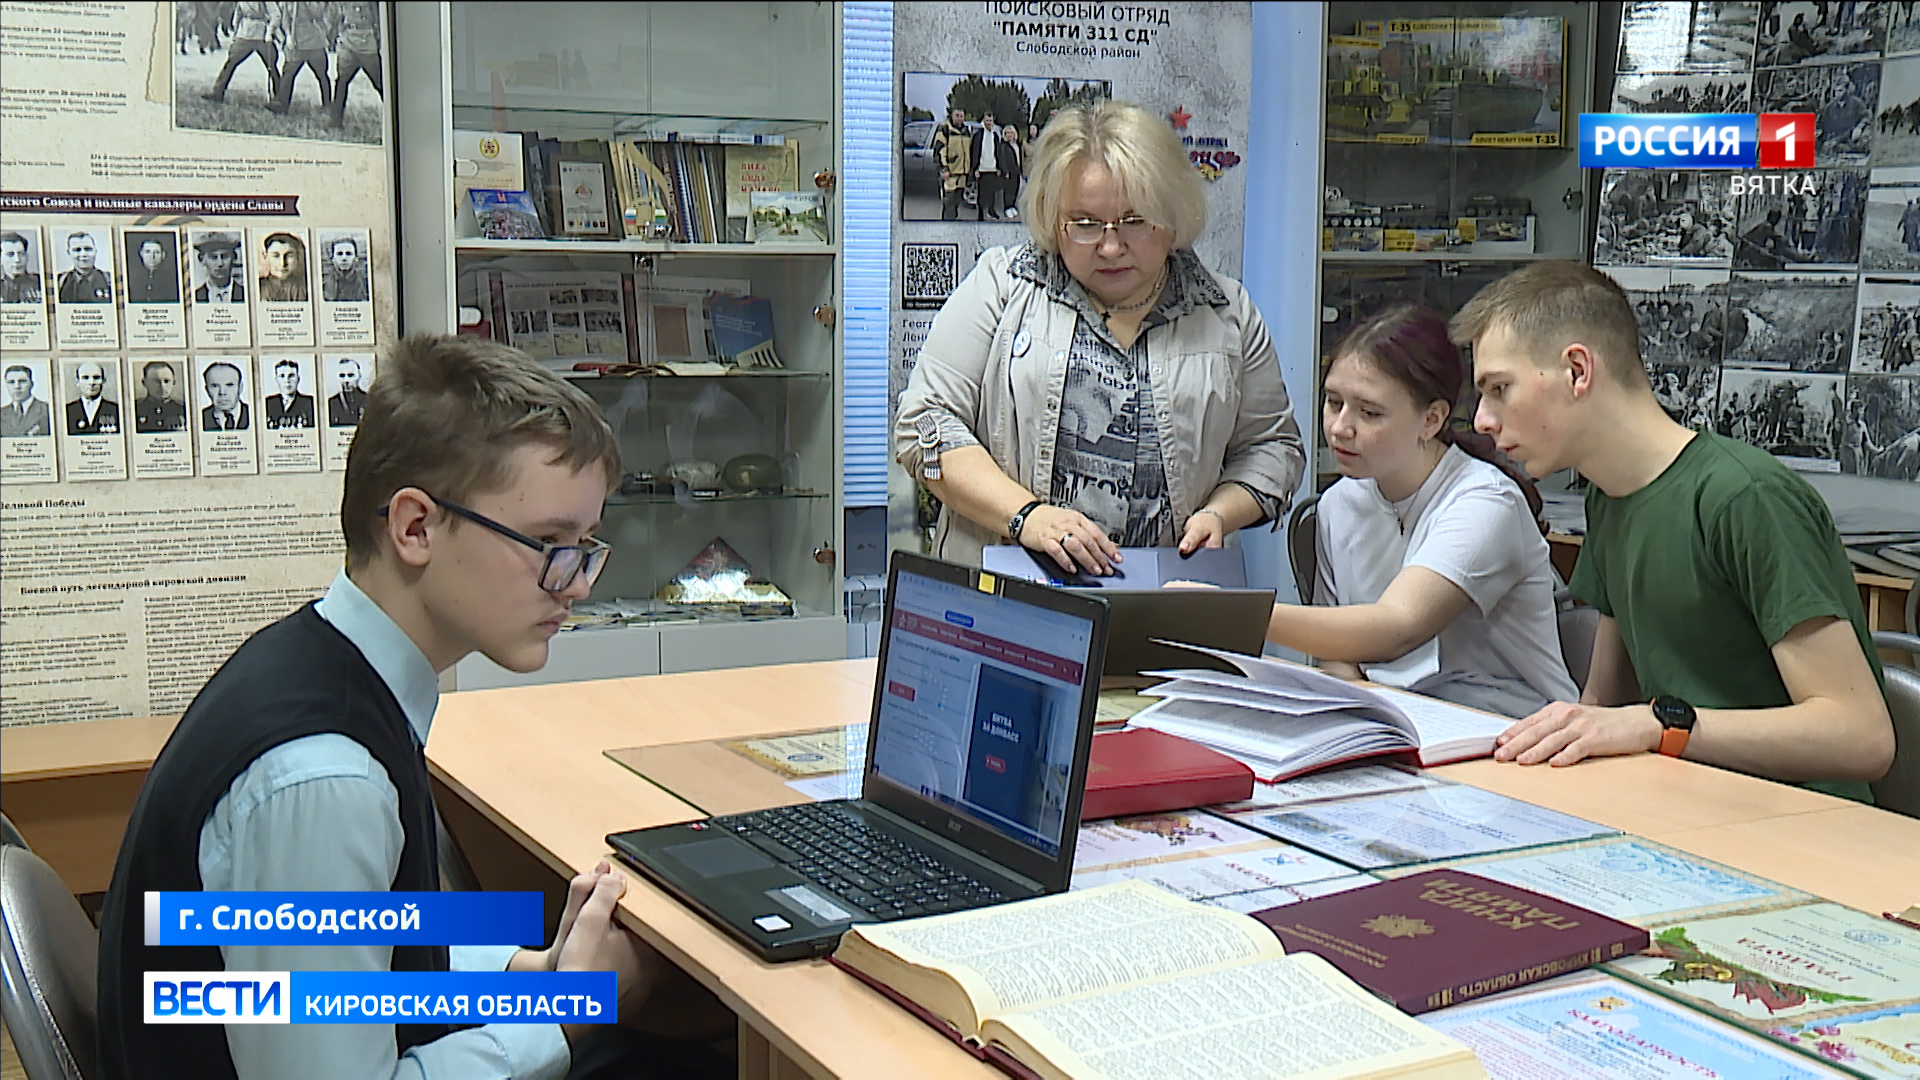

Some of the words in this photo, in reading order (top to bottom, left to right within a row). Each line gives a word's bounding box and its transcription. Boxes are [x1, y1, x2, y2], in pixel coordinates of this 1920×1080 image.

[985, 2, 1105, 20] ПОИСКОВЫЙ
[1112, 7, 1170, 27] ОТРЯД
[994, 21, 1080, 39] "ПАМЯТИ
[1086, 27, 1119, 41] 311
[1125, 29, 1158, 45] СД"
[1016, 41, 1097, 57] Слободской
[1100, 46, 1140, 60] район
[42, 196, 81, 208] Союза
[83, 198, 92, 208] и
[94, 198, 142, 209] полные
[144, 200, 202, 212] кавалеры
[204, 201, 245, 212] ордена
[247, 200, 284, 210] Славы
[45, 498, 86, 508] Победы
[20, 584, 58, 596] Боевой
[60, 584, 84, 595] путь
[86, 579, 150, 592] легендарной
[152, 576, 204, 588] кировской
[206, 573, 246, 585] дивизии
[1419, 889, 1535, 930] КНИГА
[1423, 879, 1581, 931] ПАМЯТИ
[1519, 952, 1589, 986] КИРОВСКАЯ
[1458, 972, 1516, 998] ОБЛАСТЬ
